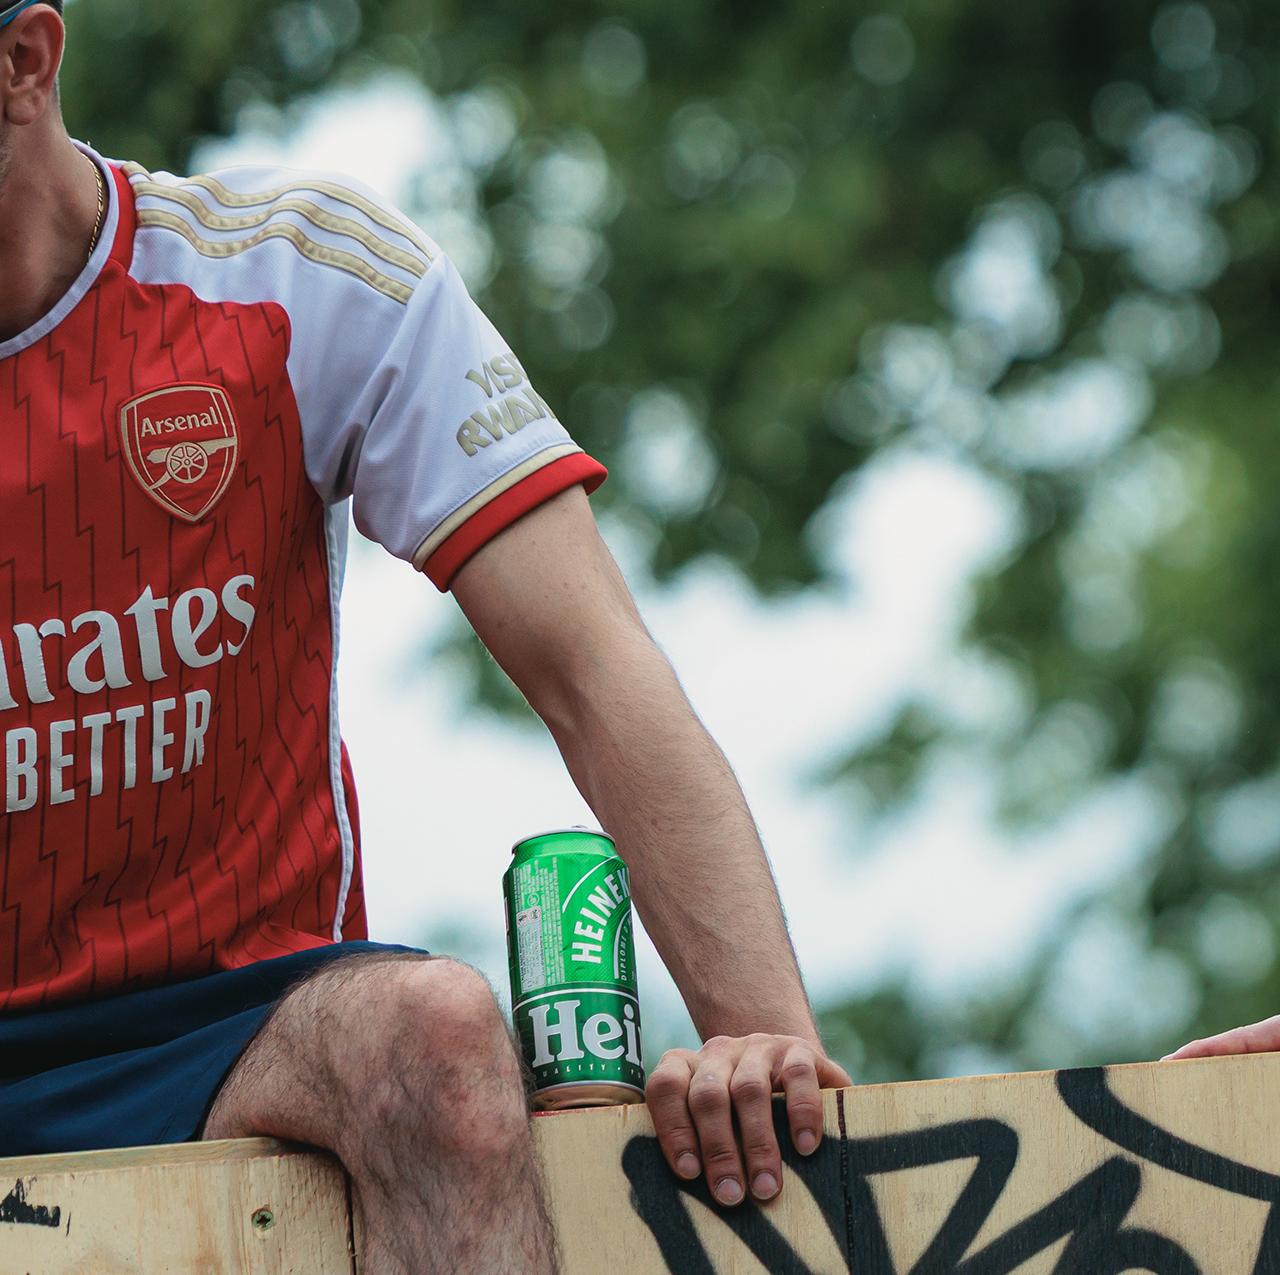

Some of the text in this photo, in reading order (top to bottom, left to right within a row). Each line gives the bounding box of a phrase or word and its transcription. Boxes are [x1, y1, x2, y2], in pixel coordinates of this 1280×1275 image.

[465, 352, 529, 398] VISI
[141, 407, 219, 438] Arsenal
[456, 387, 557, 458] RWAN
[6, 689, 211, 813] BETTER
[571, 867, 631, 964] HEINEK
[528, 1000, 643, 1068] Hei
